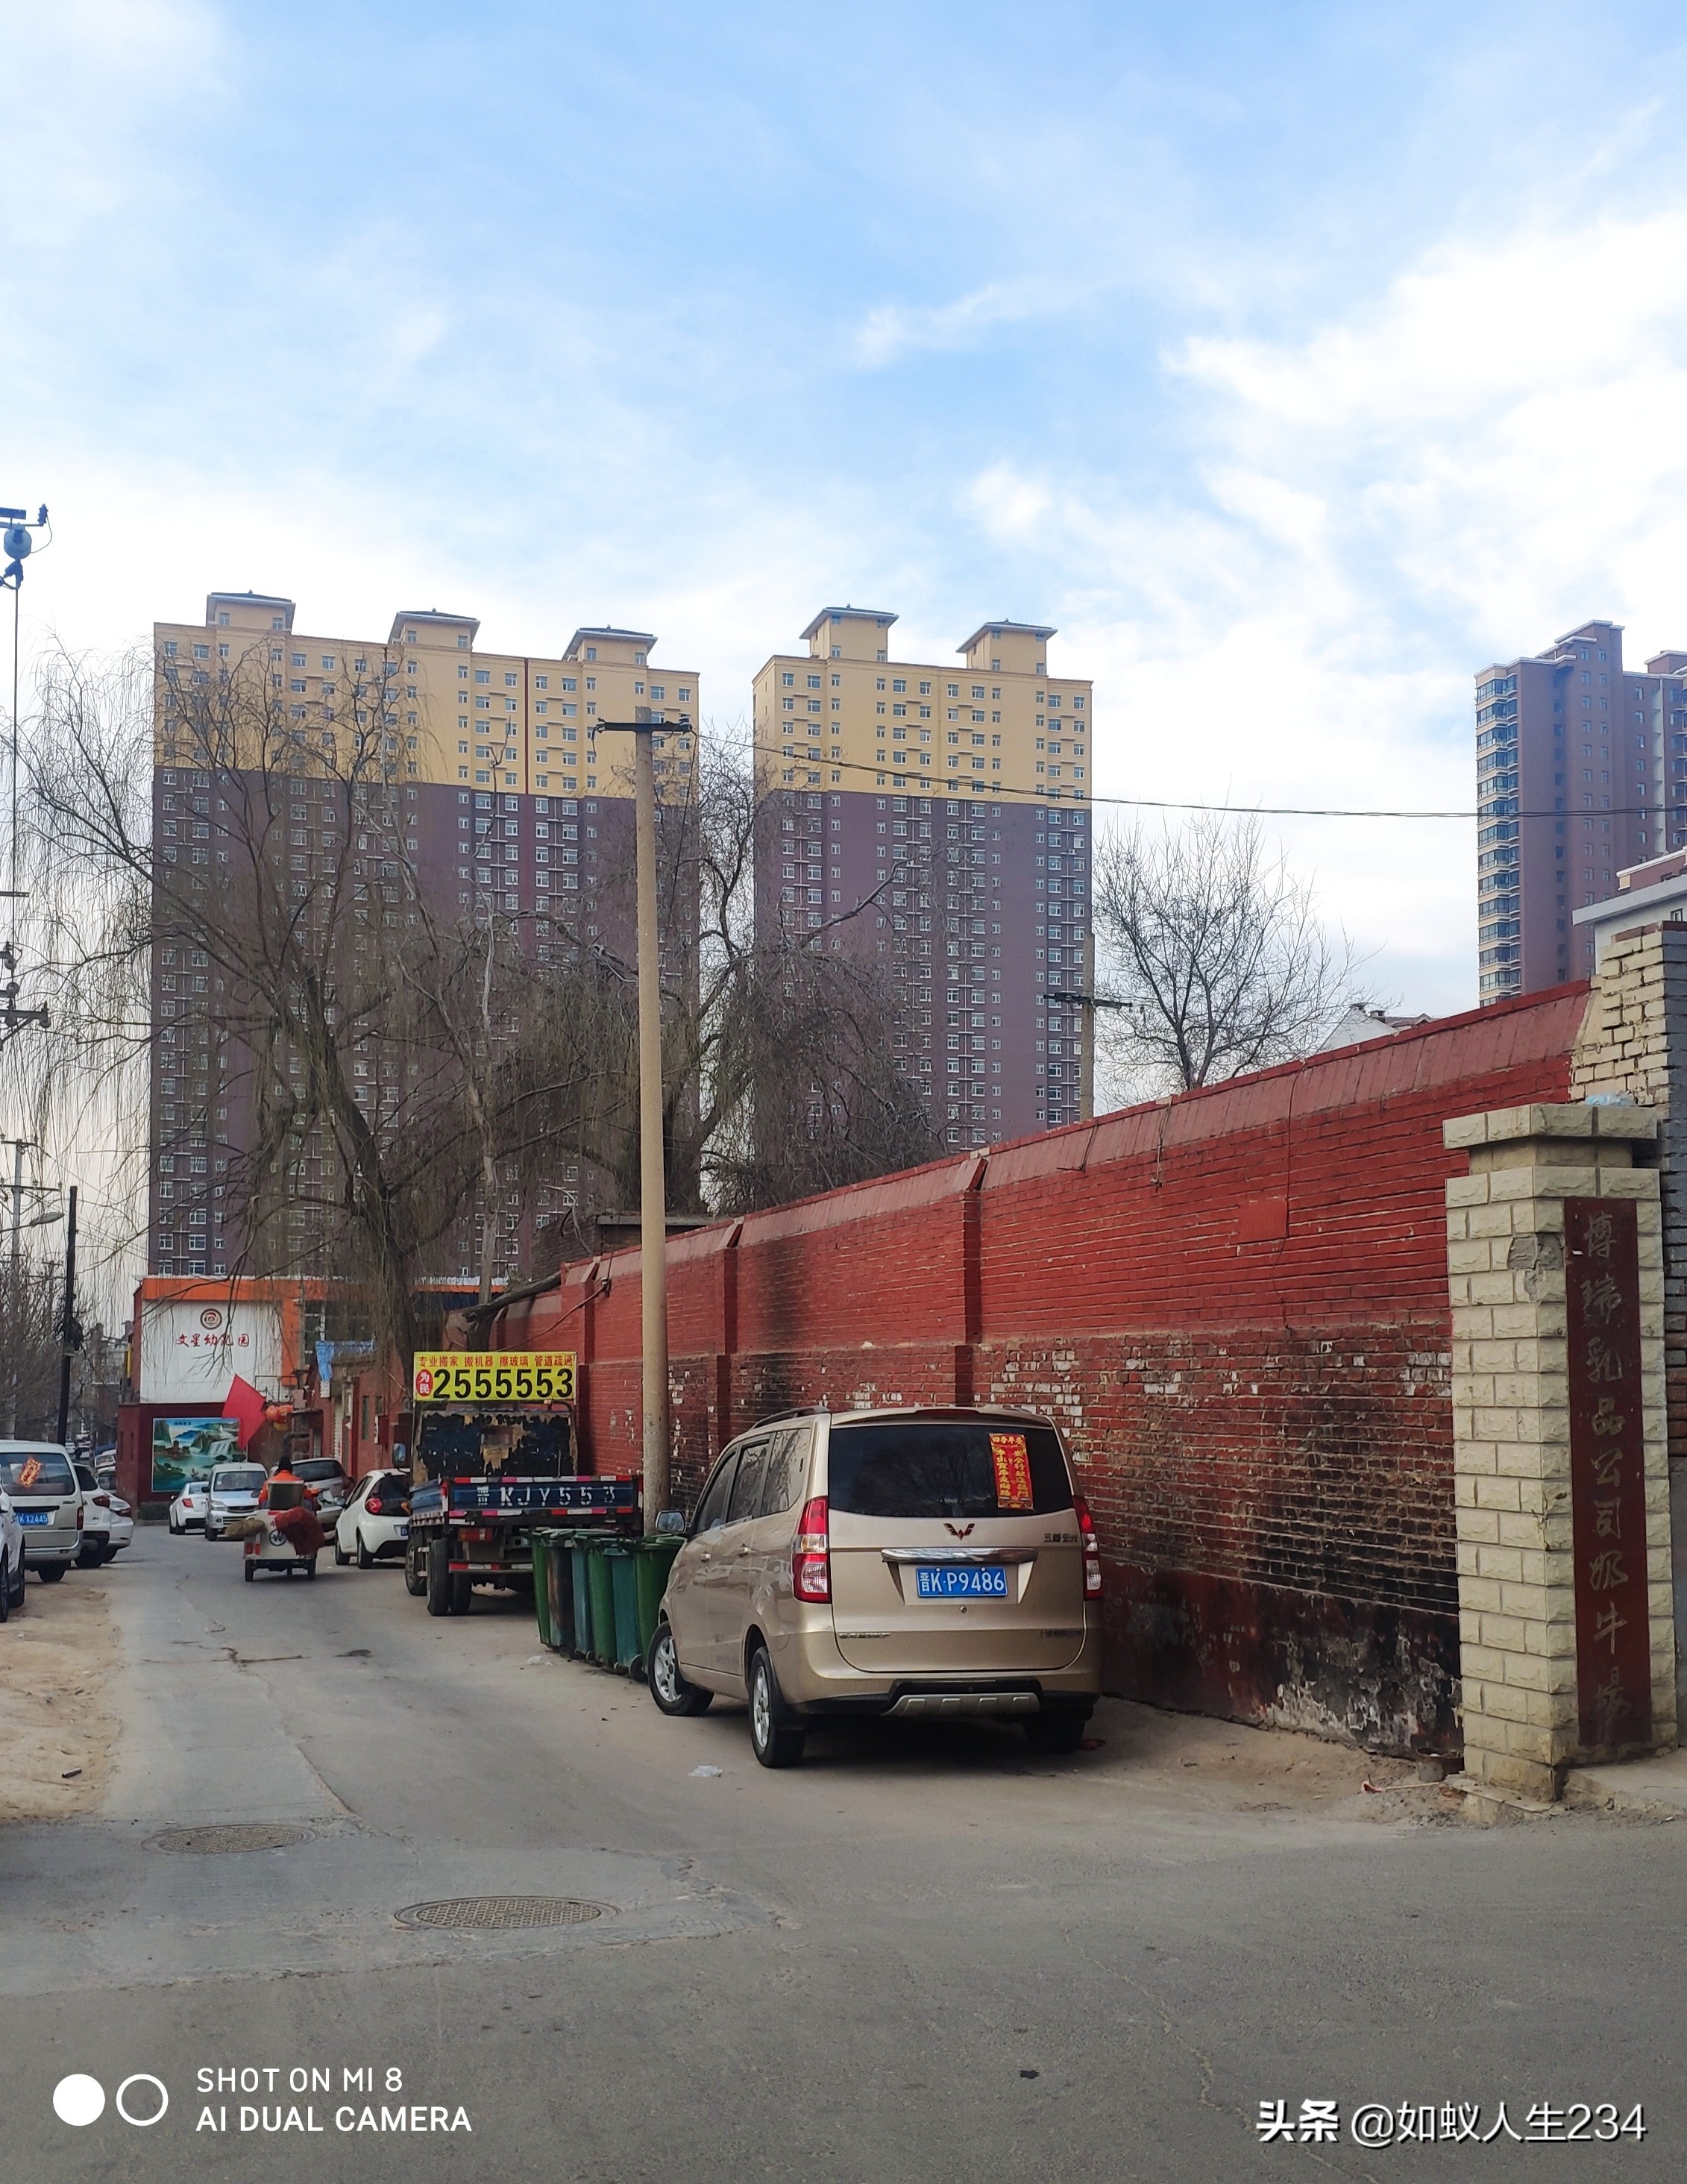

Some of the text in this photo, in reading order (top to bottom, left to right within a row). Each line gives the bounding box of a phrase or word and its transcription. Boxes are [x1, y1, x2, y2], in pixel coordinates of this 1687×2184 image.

[176, 1333, 249, 1348] 文星幼儿园
[418, 1355, 574, 1367] 专业搬家 搬机器 擦玻璃 管道疏通
[419, 1372, 430, 1394] 为民
[433, 1368, 574, 1399] 2555553
[19, 1513, 48, 1524] KX2445
